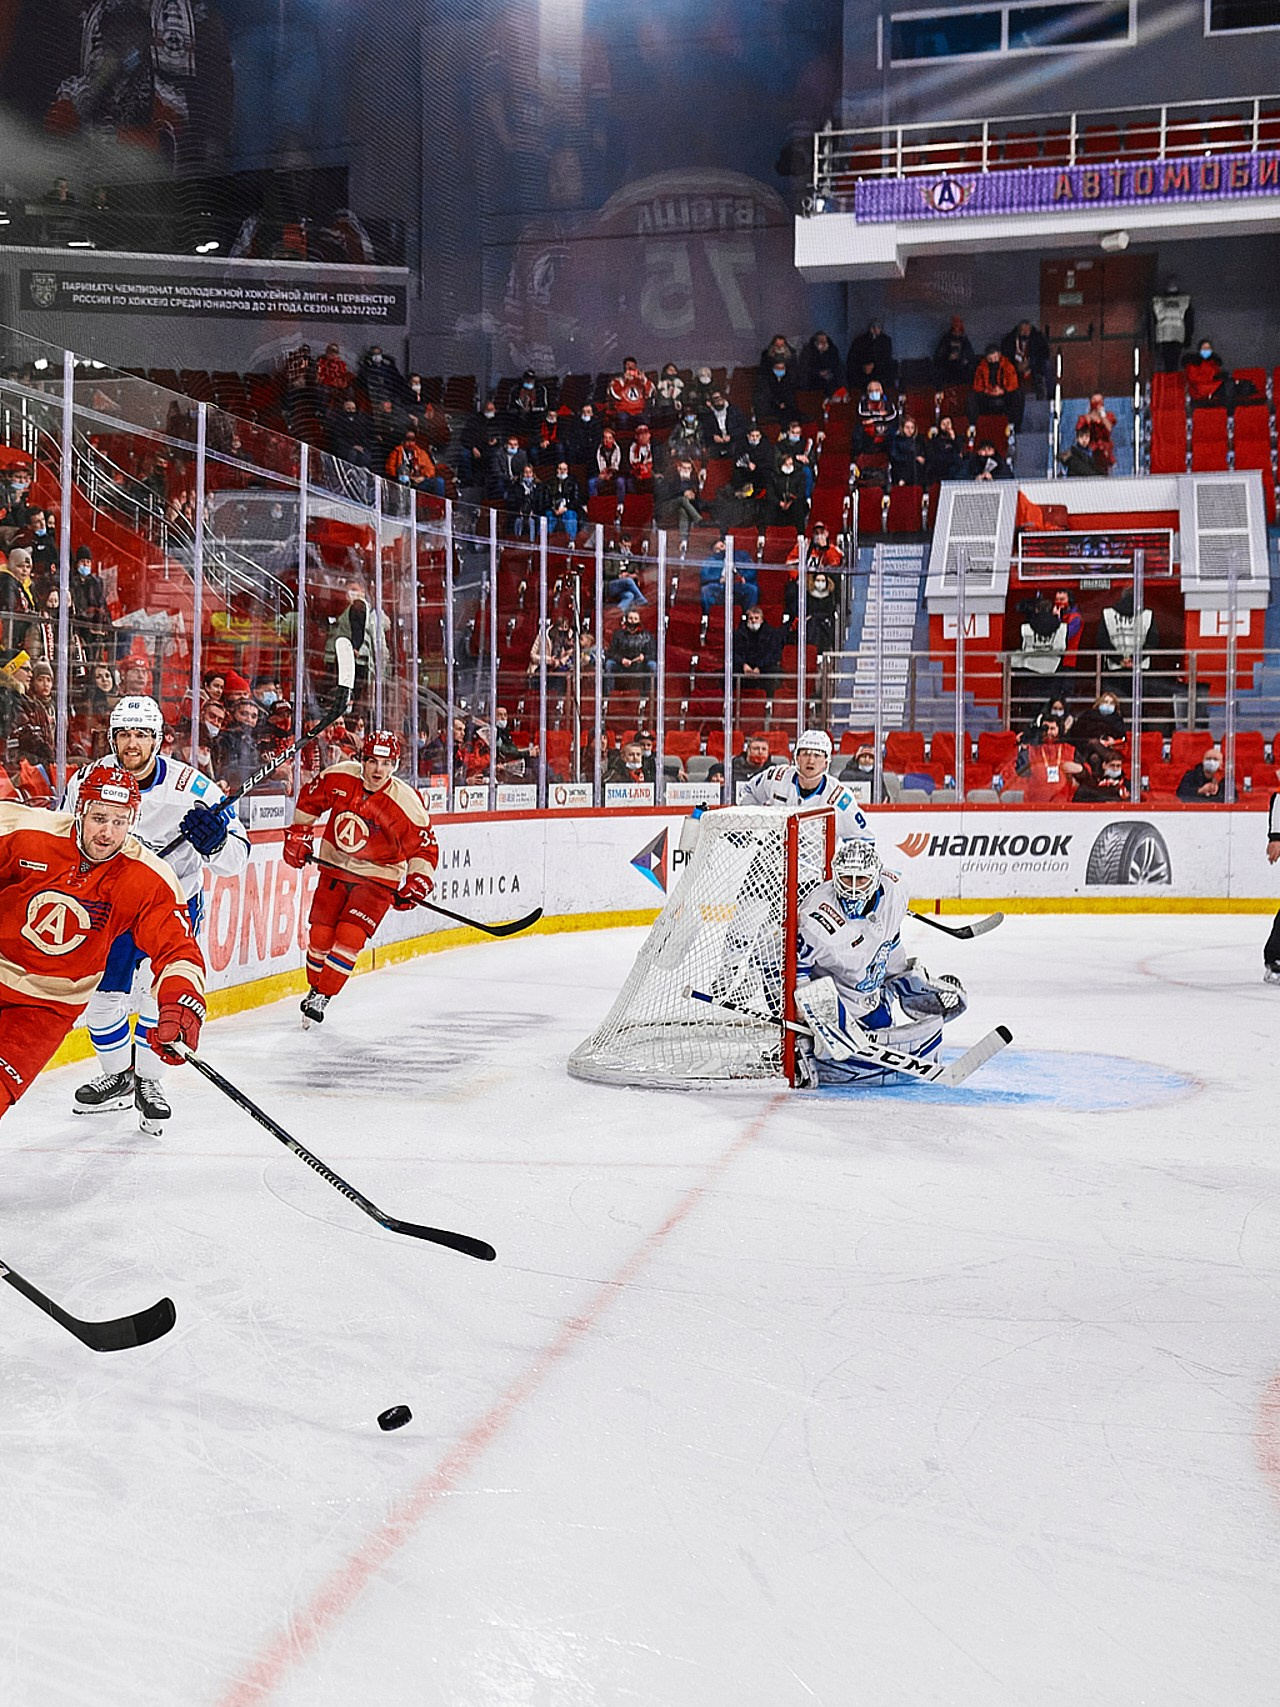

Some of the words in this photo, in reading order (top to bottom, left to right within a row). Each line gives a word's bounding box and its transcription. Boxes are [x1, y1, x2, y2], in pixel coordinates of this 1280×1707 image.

[72, 293, 111, 305] РОССИИ
[113, 295, 126, 306] ПО
[170, 298, 201, 309] СРЕДИ
[252, 302, 266, 313] ДО
[278, 303, 302, 314] ГОДА
[303, 304, 340, 316] СЕЗОНА
[302, 291, 328, 302] ЛИГИ
[336, 292, 396, 304] ПЕРВЕНСТВО
[854, 812, 867, 829] 9
[961, 859, 1007, 875] driving
[1011, 860, 1069, 873] emotion
